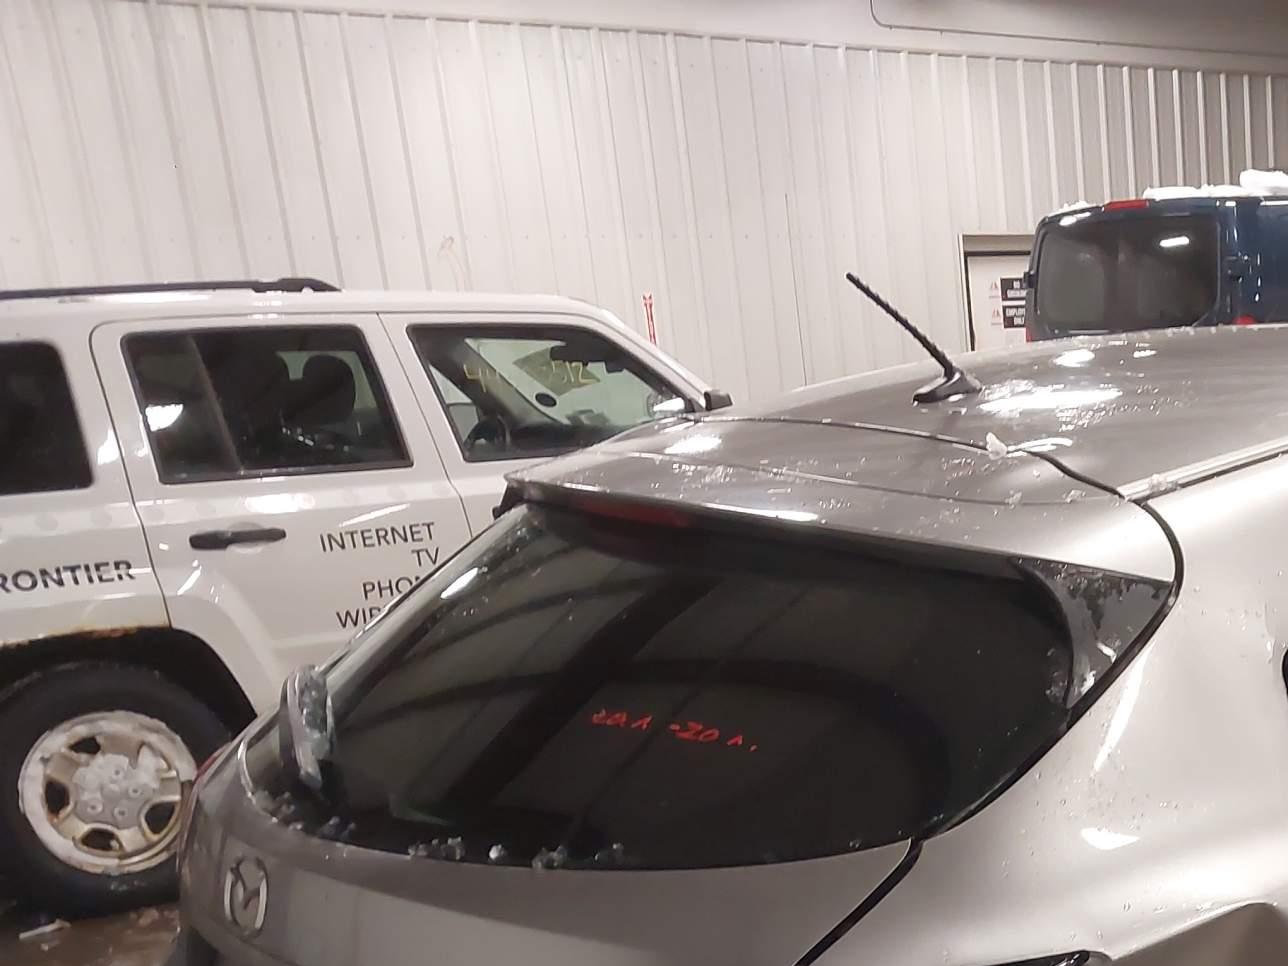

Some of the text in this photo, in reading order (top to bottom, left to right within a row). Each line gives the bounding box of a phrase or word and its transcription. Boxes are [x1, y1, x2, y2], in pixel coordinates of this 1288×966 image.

[320, 521, 435, 552] INTERNET
[411, 546, 439, 567] TV
[362, 576, 420, 600] PHO
